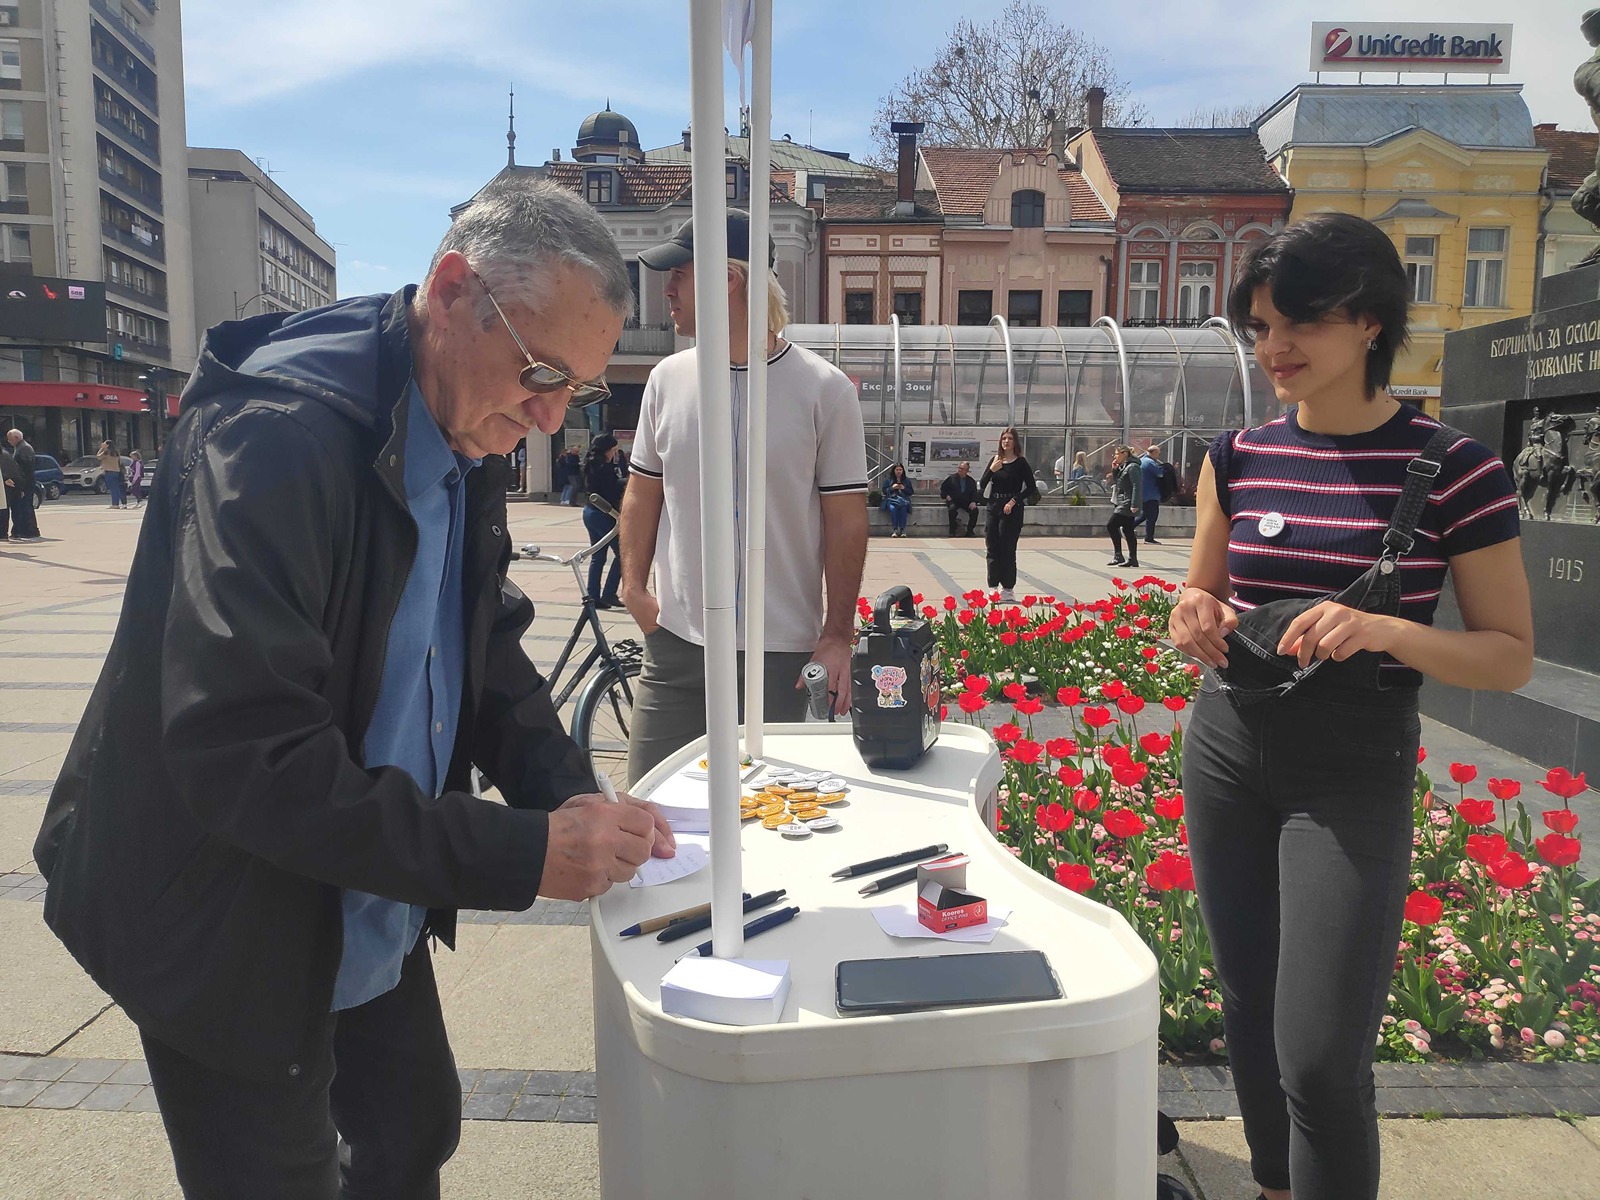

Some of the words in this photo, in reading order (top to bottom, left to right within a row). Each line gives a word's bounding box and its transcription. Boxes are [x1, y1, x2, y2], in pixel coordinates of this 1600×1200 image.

[1358, 33, 1446, 56] UniCredit
[1451, 33, 1503, 57] Bank
[1546, 327, 1561, 349] ЗА
[1565, 319, 1600, 345] ОСЛО
[905, 383, 932, 391] Зоки
[1412, 388, 1428, 396] Bank
[1549, 557, 1584, 582] 1915
